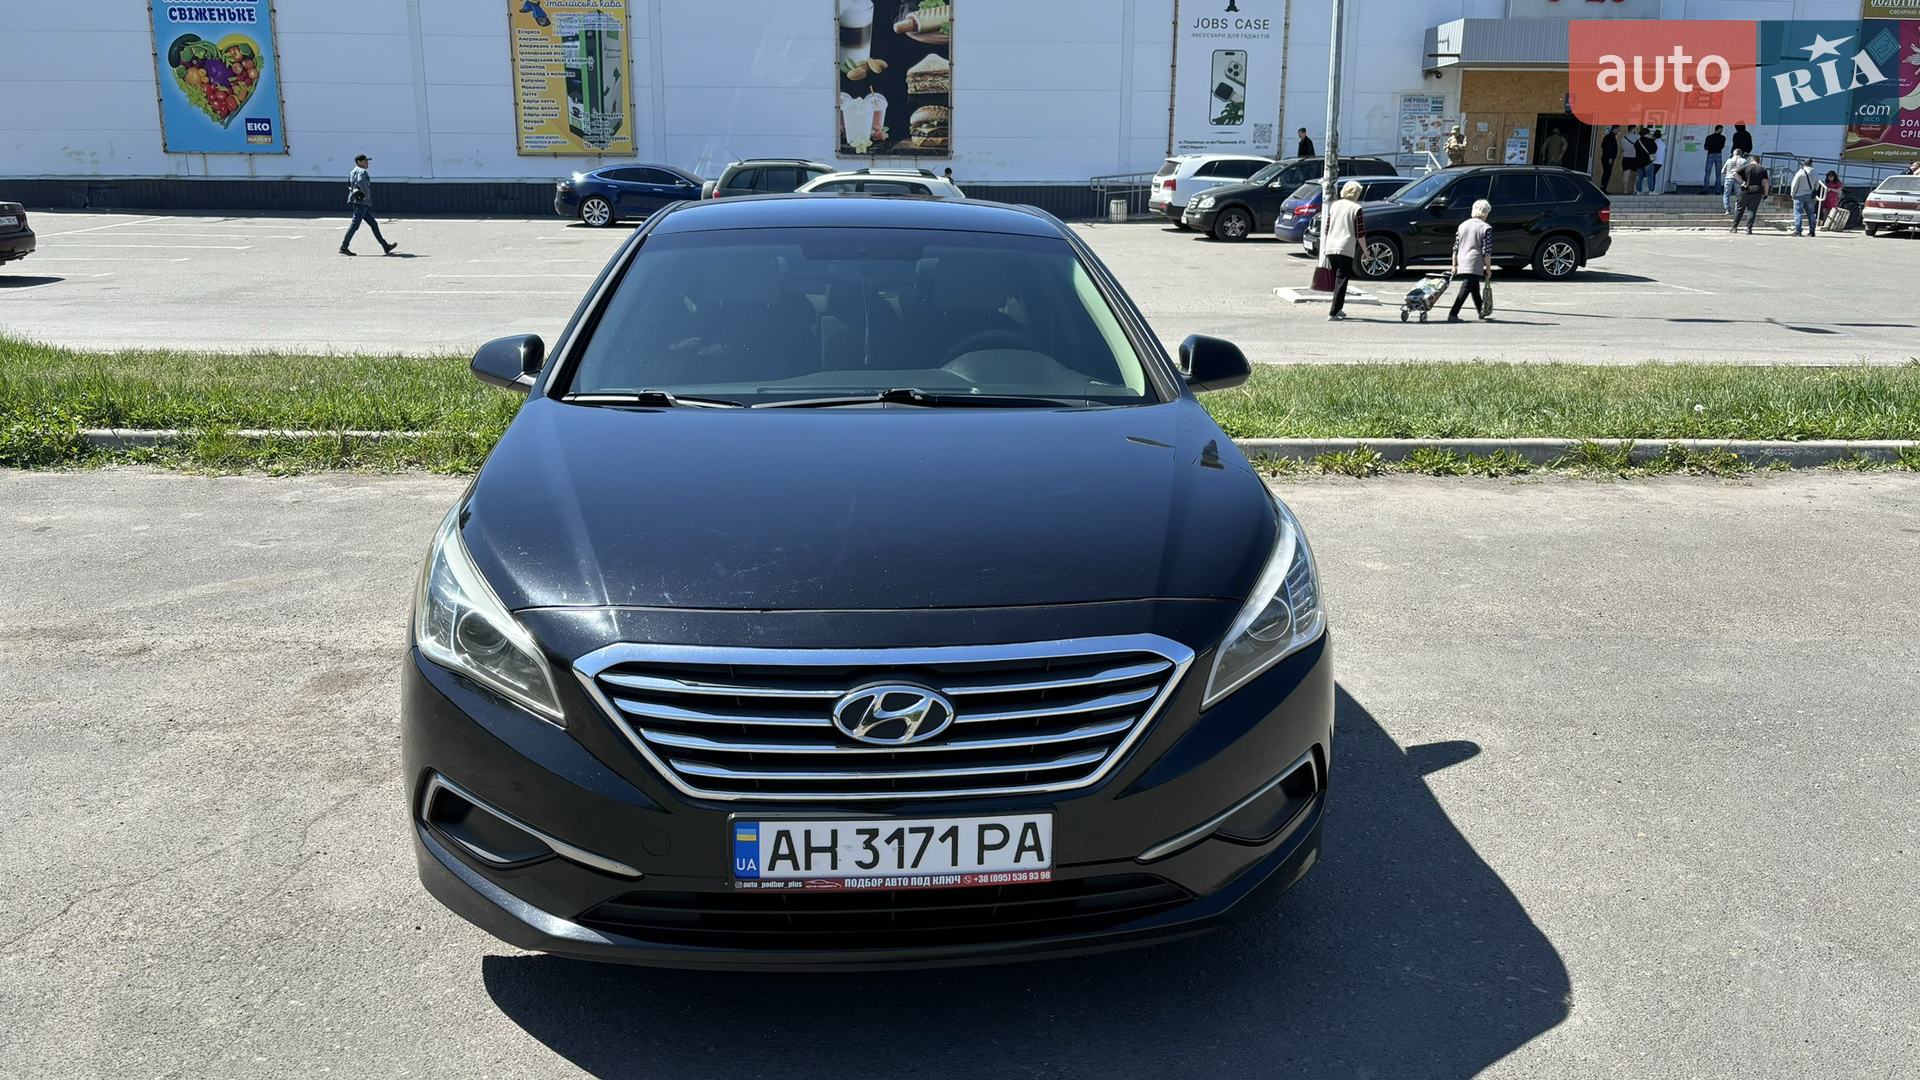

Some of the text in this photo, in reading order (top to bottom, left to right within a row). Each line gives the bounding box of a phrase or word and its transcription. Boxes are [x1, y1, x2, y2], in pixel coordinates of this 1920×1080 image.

[168, 7, 256, 22] СВІЖЕНЬКЕ
[1193, 18, 1270, 30] JOBS CASE
[247, 122, 270, 131] ЕКО
[767, 821, 1045, 874] AH 3171 PA
[736, 858, 757, 871] UA
[844, 874, 961, 889] ПОДБОР АВТО ПОД КЛЮЧ
[973, 870, 1051, 884] +38 (095) 536 93 98
